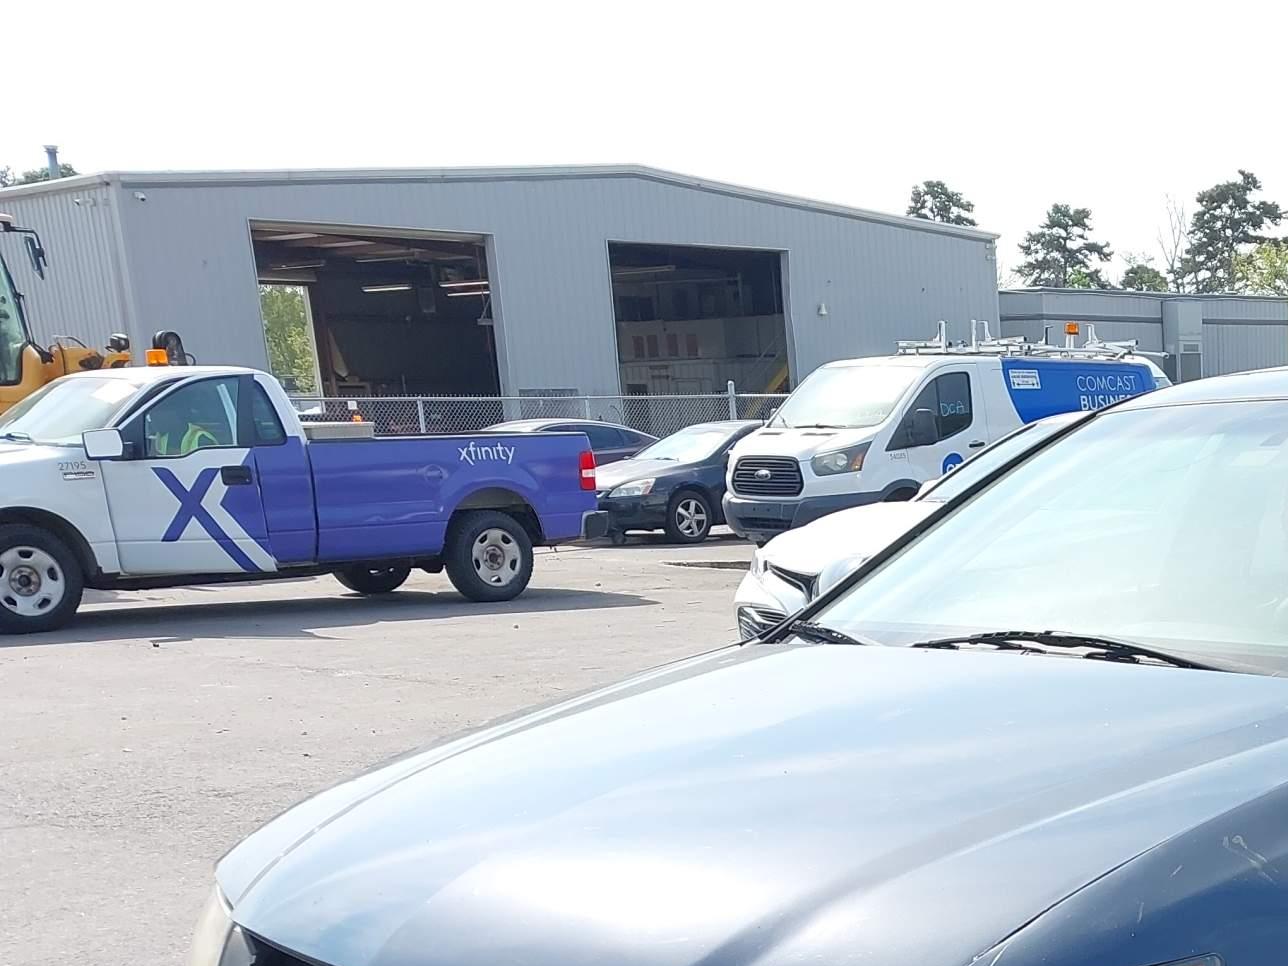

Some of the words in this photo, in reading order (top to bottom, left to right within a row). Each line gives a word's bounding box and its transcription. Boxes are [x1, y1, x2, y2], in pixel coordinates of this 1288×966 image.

[1076, 375, 1137, 392] COMCAST
[1080, 394, 1132, 411] BUSIN
[457, 440, 516, 466] xfinity
[57, 460, 88, 471] 27195
